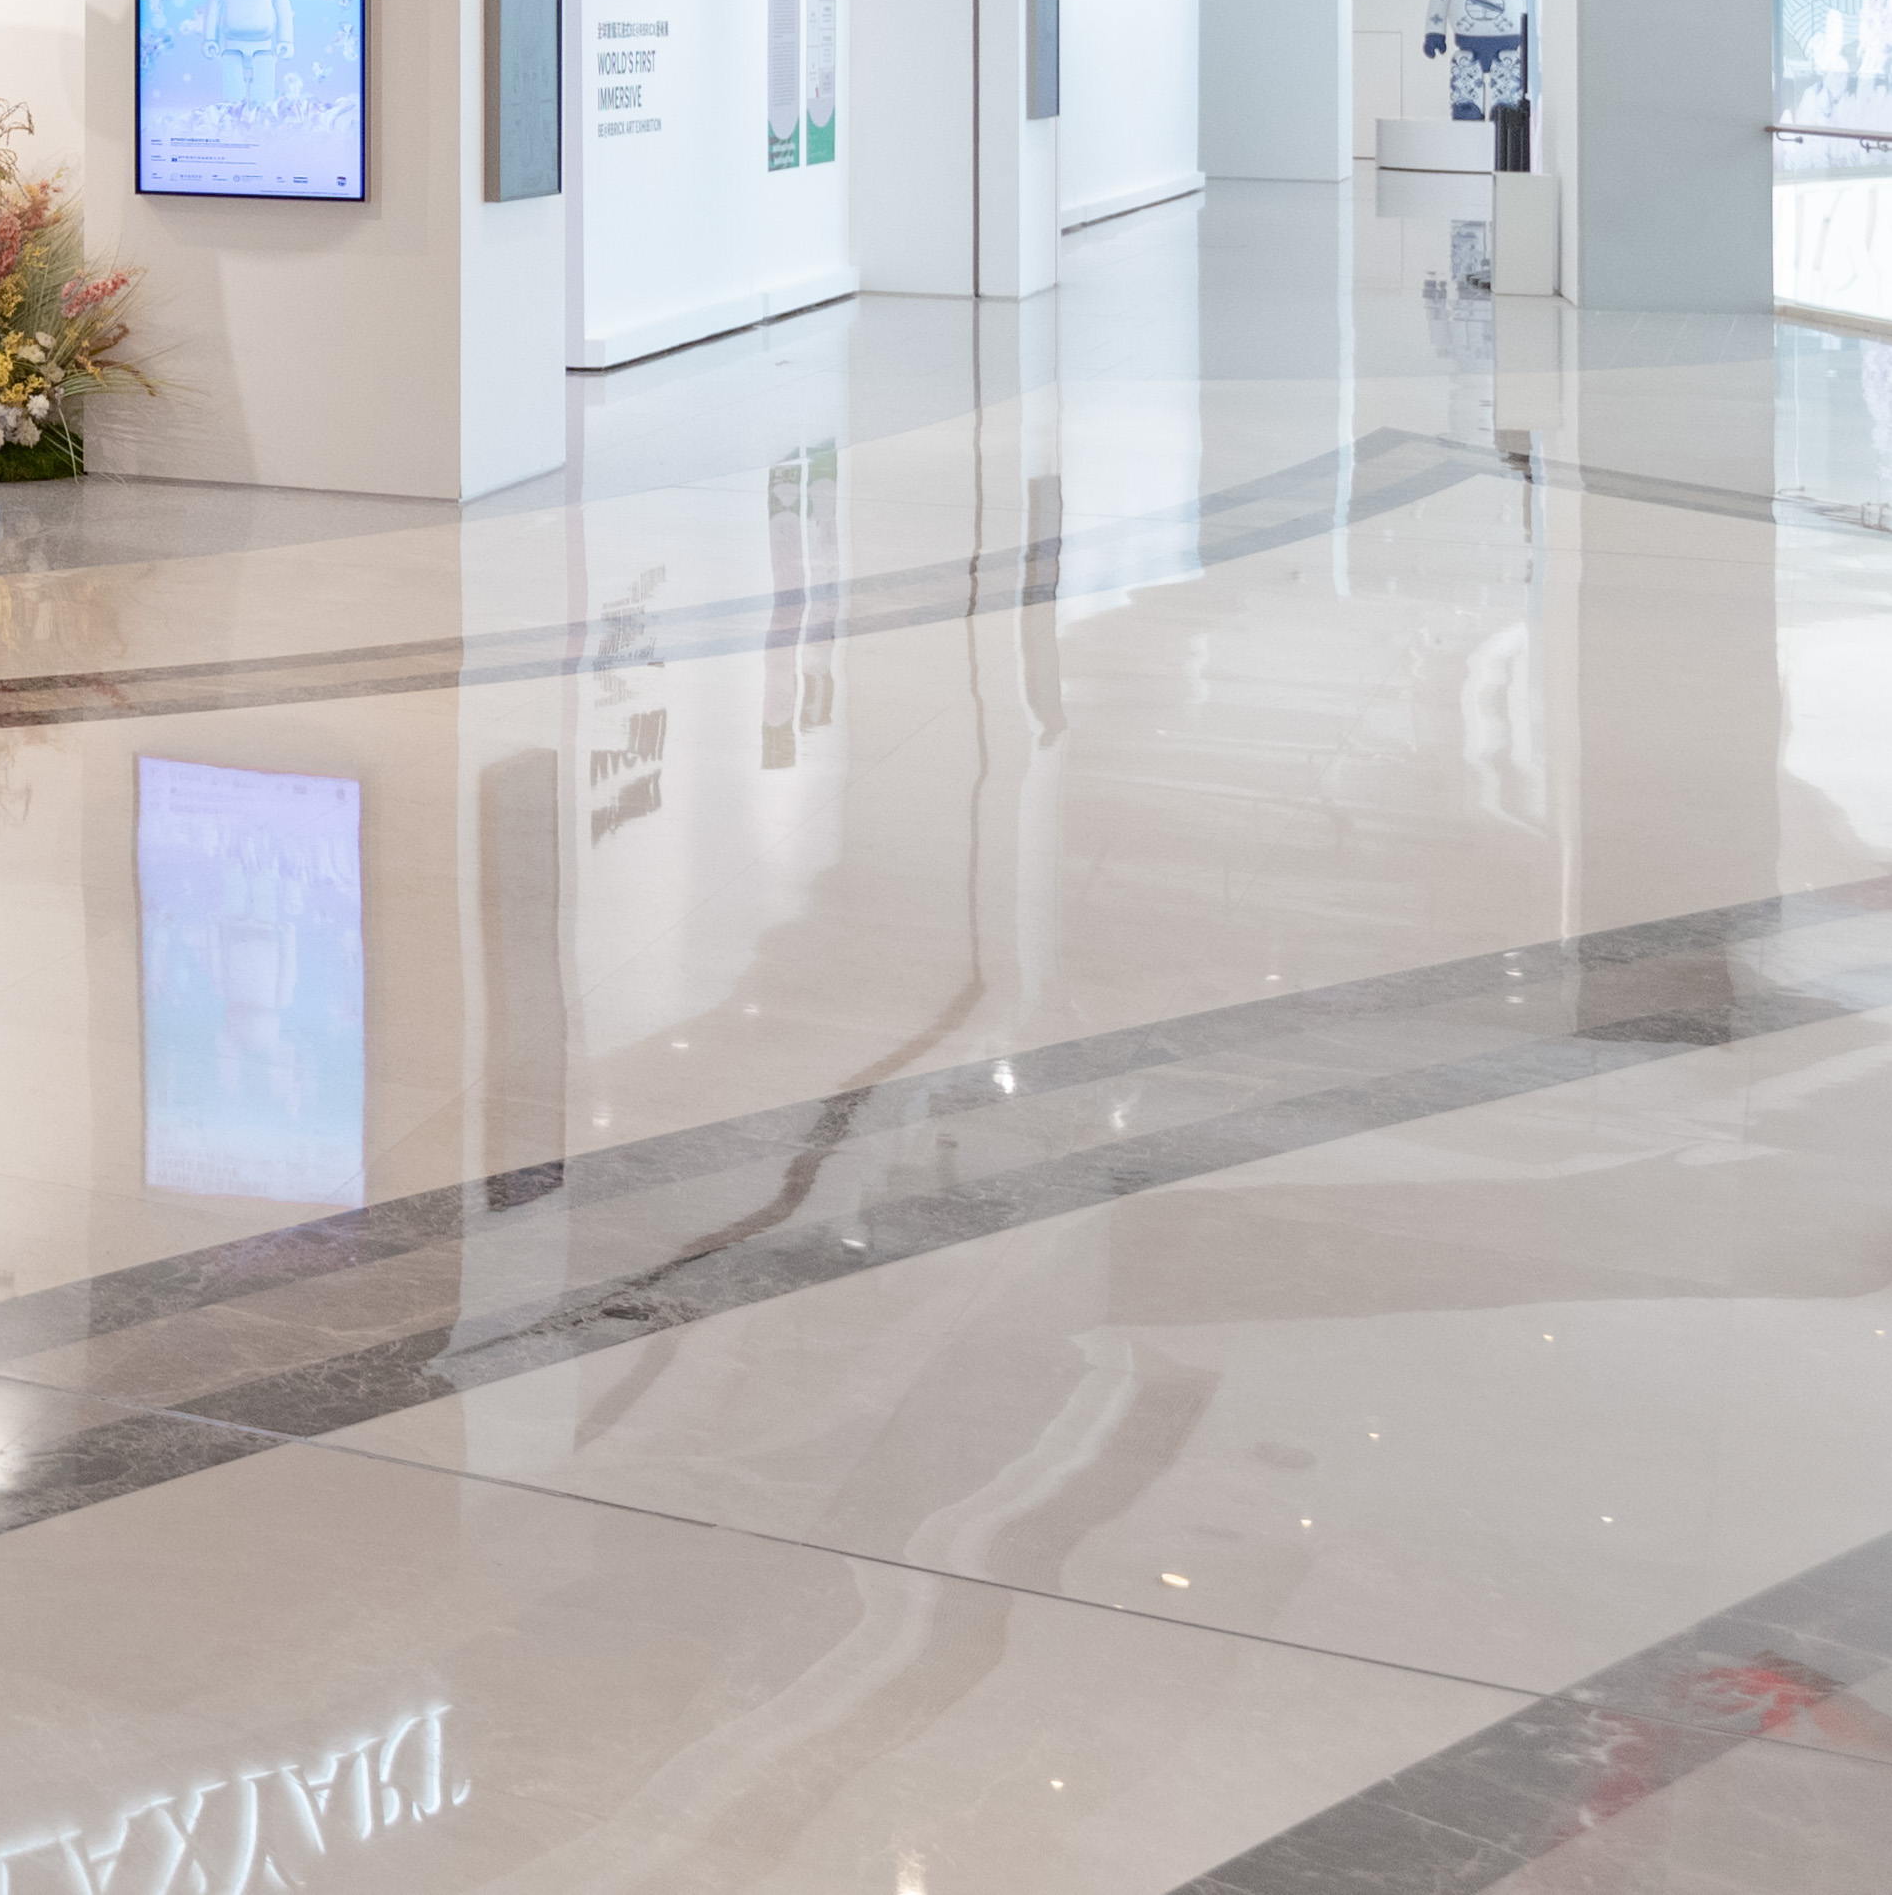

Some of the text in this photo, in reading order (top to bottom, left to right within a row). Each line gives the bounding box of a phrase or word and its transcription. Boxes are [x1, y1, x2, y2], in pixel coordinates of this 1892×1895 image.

[597, 50, 656, 76] WORLD'S FIRST
[598, 85, 641, 111] IMMERSIVE
